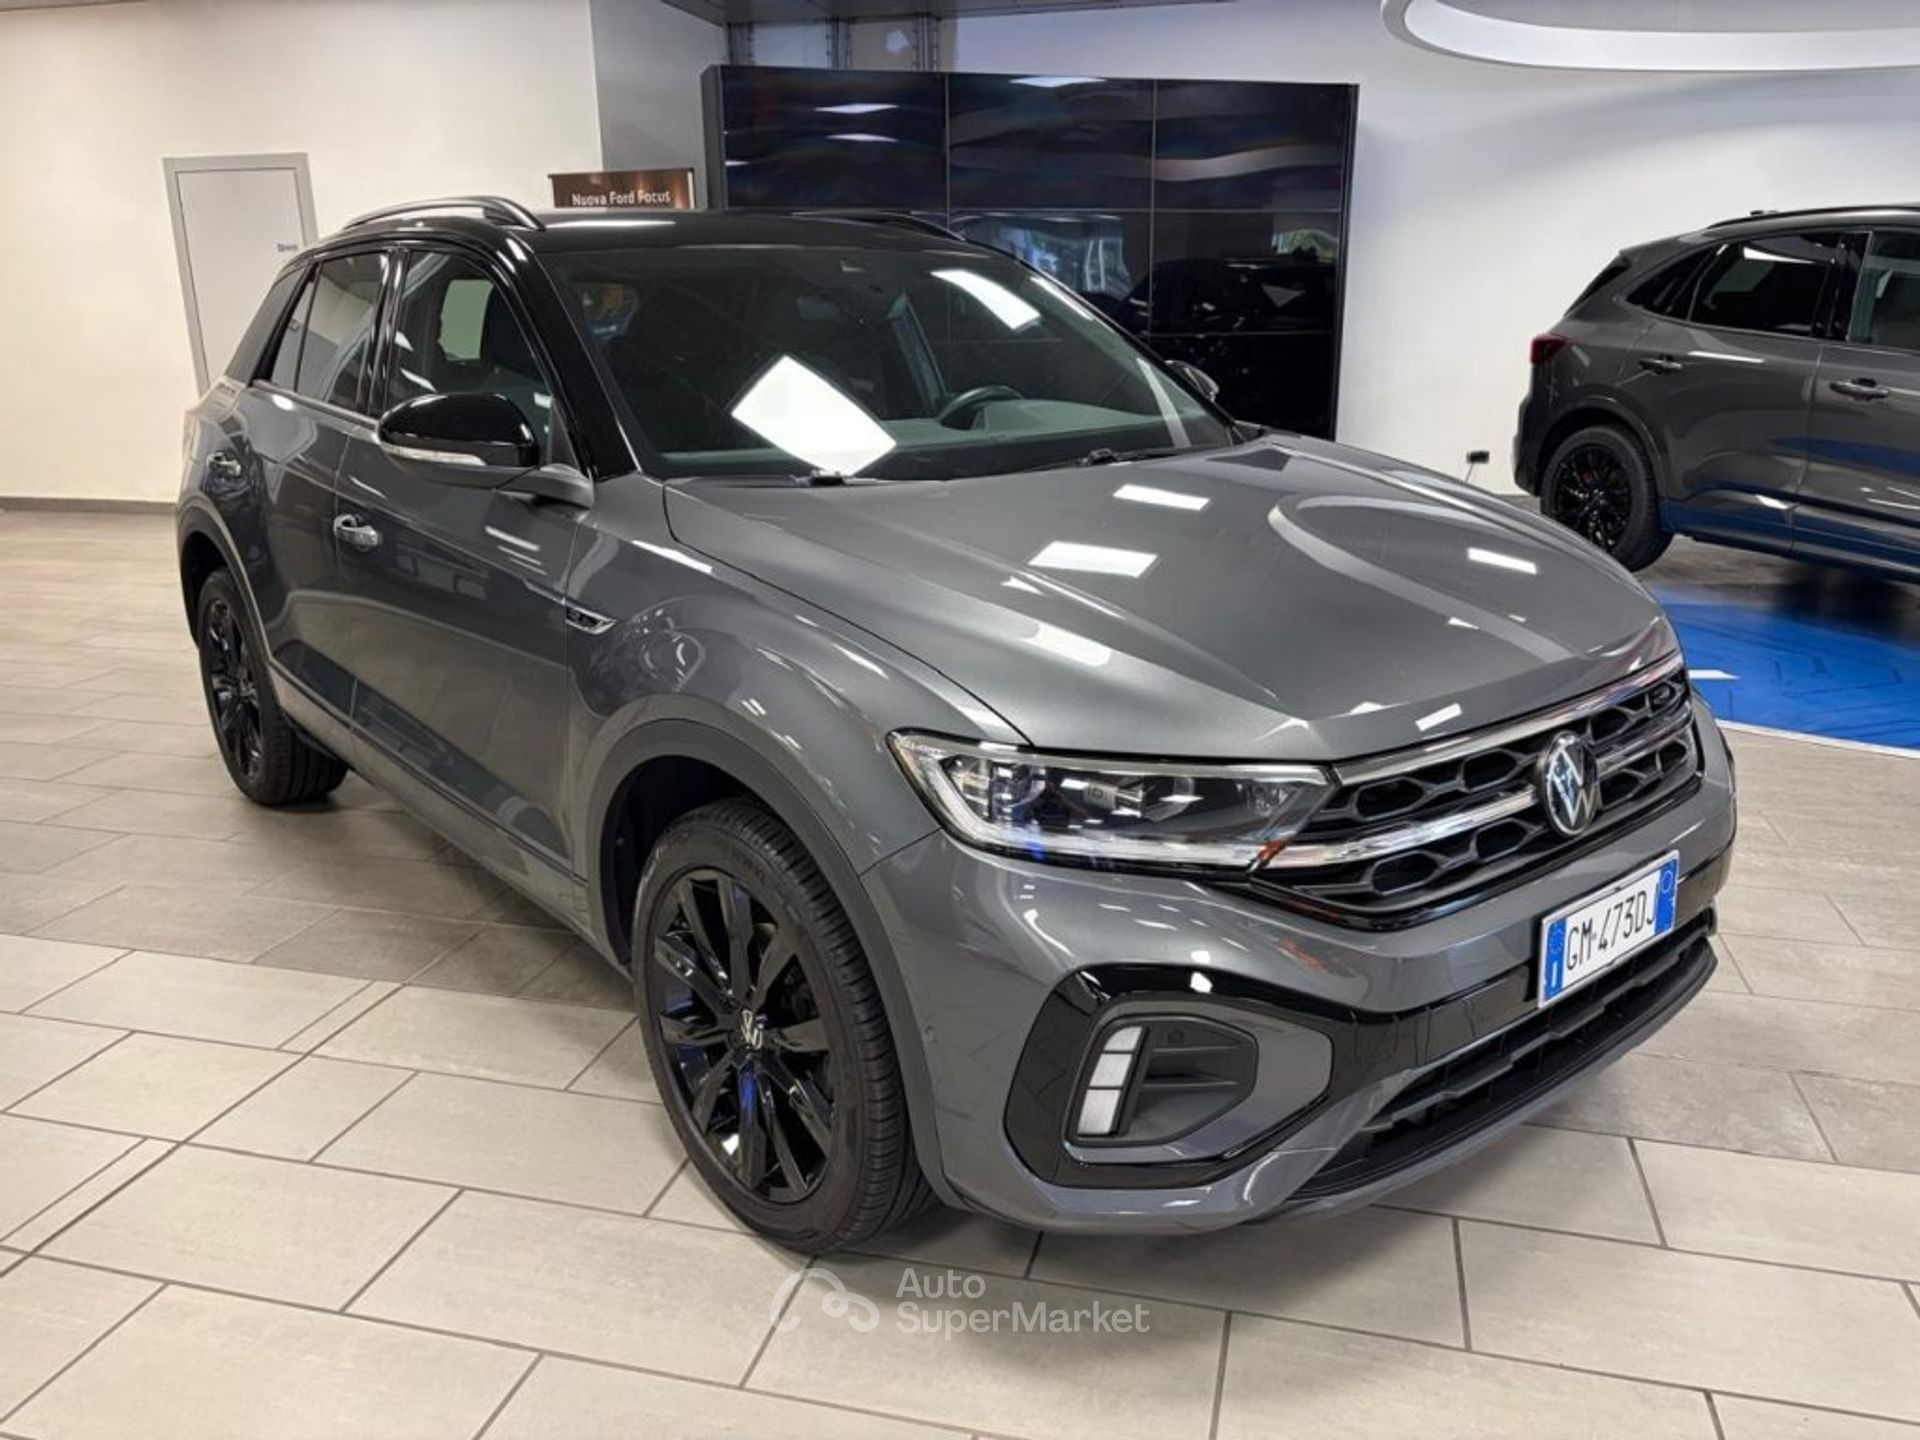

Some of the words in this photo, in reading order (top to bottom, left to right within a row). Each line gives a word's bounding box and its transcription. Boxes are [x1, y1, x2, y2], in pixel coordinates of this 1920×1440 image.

[572, 193, 607, 206] Nuova
[609, 191, 635, 204] Ford
[637, 189, 671, 203] Focus
